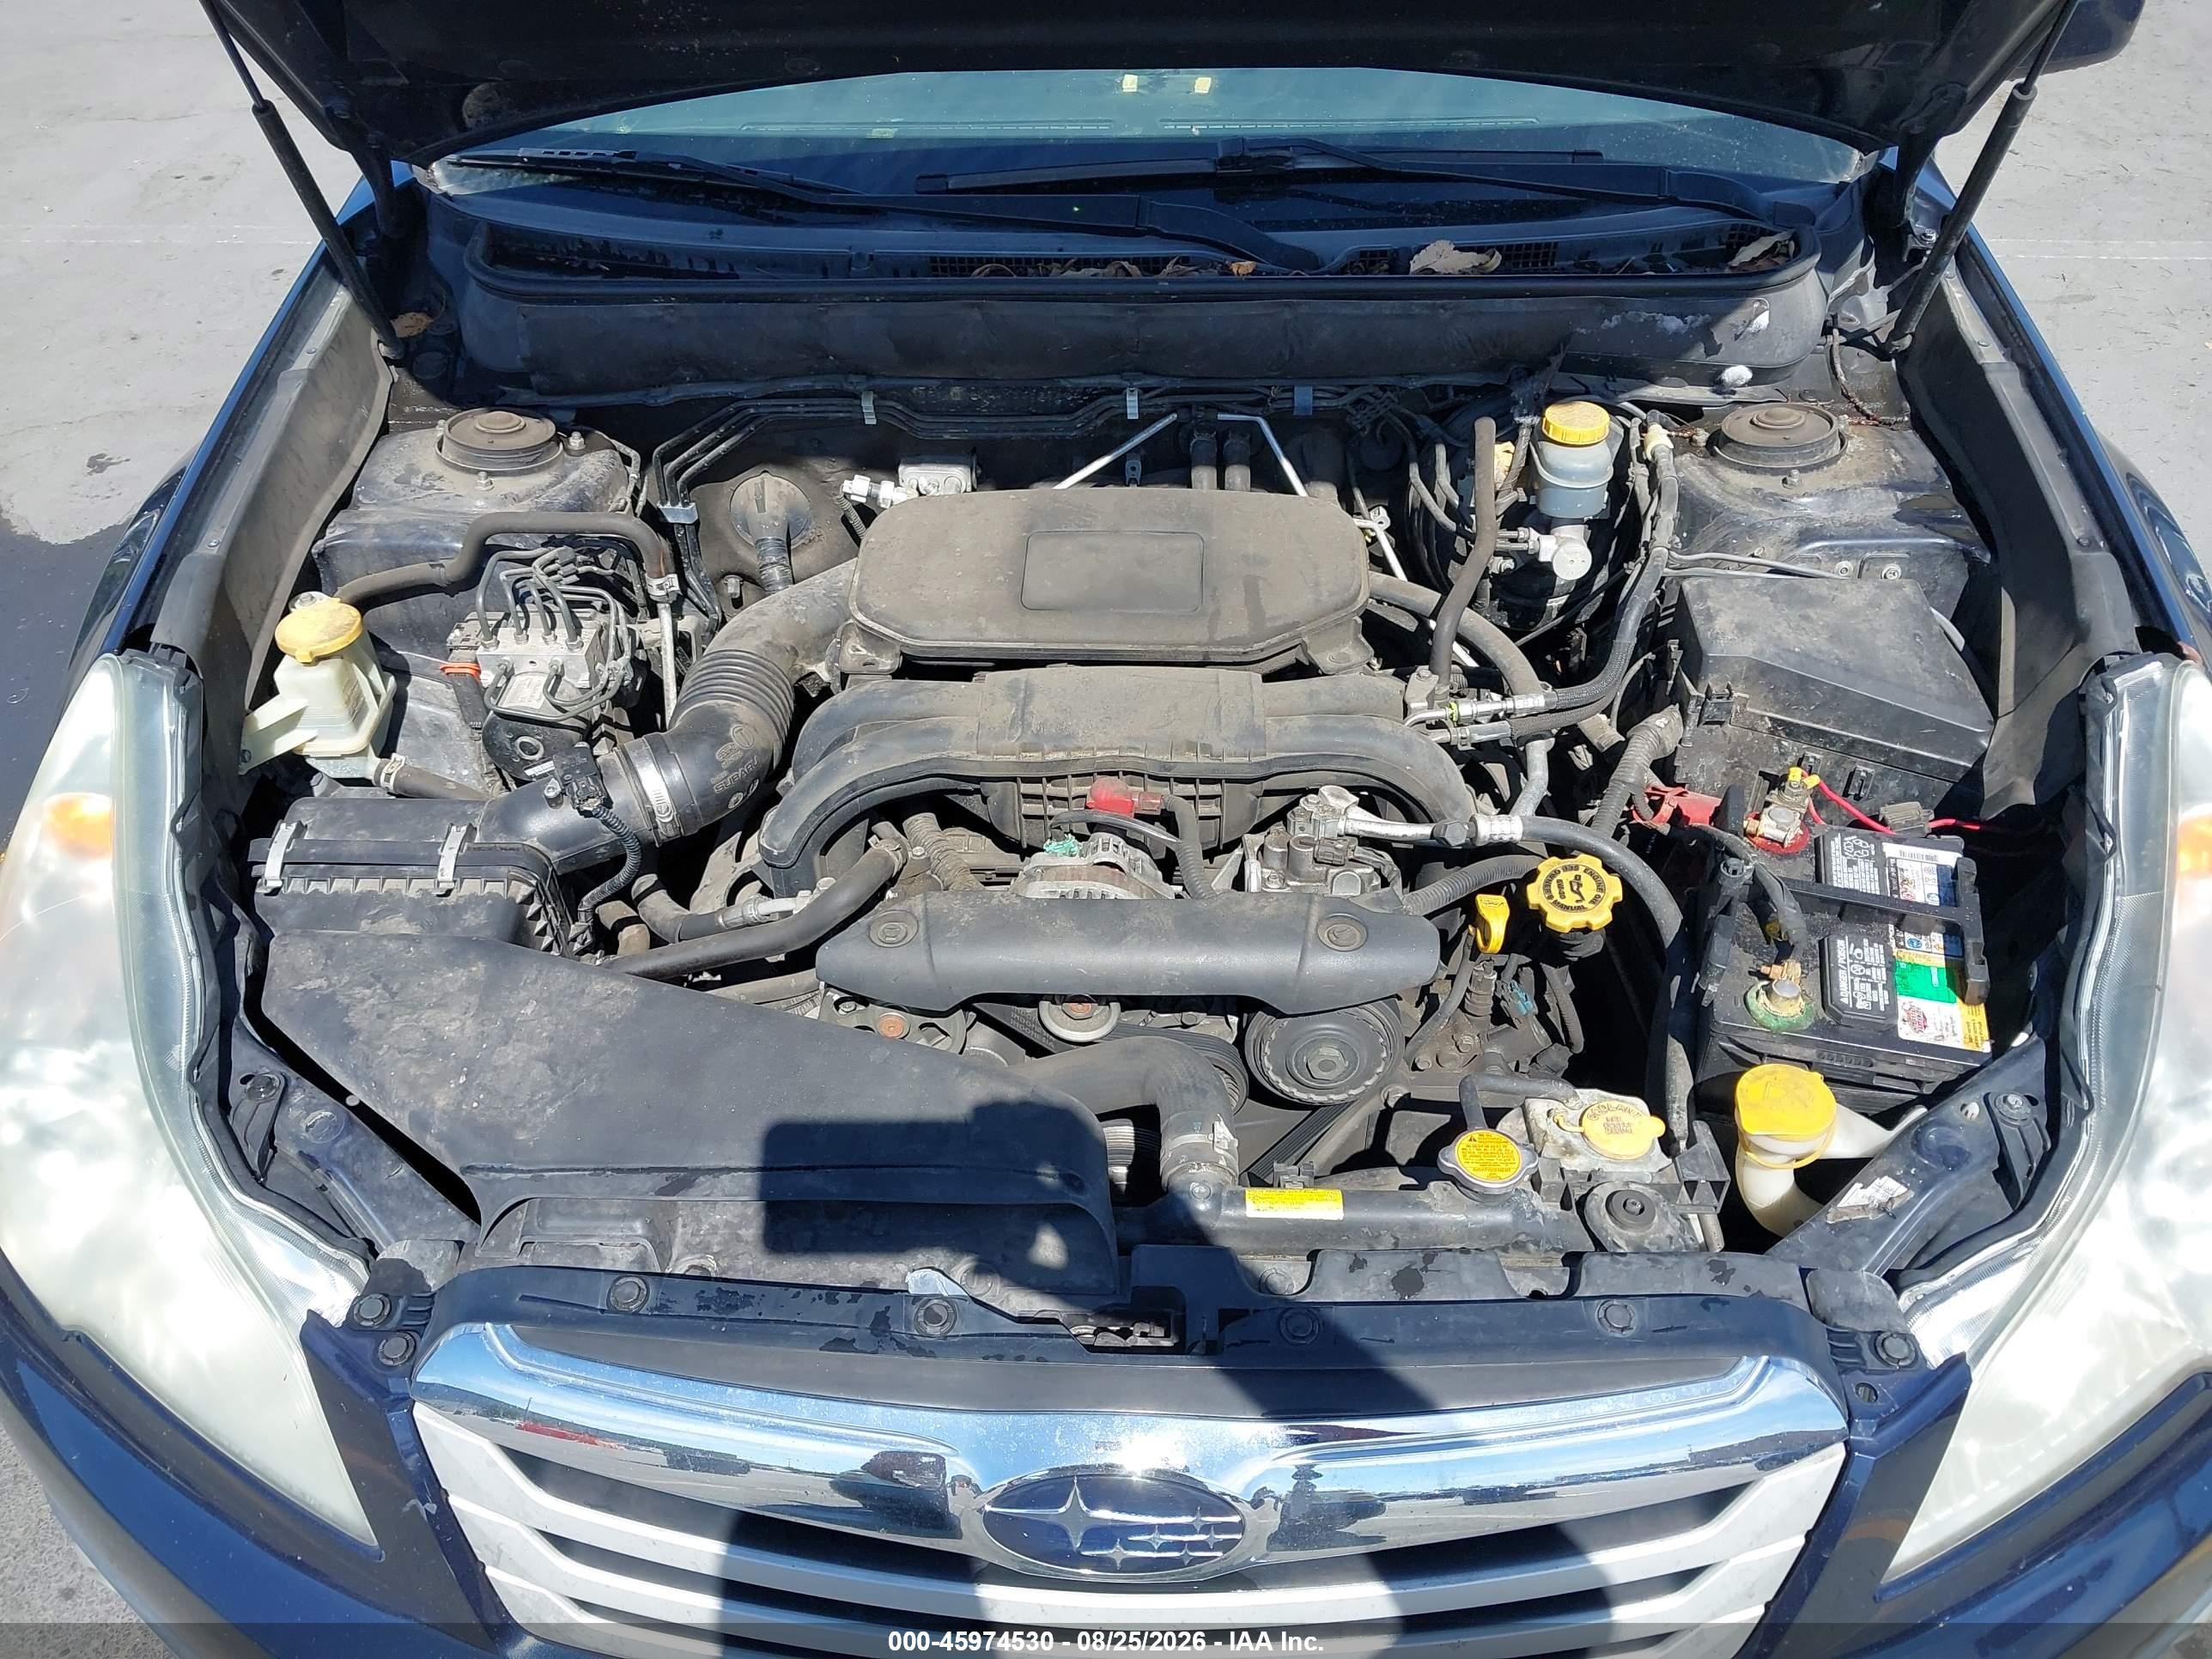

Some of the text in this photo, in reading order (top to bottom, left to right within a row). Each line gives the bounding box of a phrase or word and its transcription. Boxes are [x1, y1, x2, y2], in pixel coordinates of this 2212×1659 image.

[714, 756, 758, 793] SUBARU
[1583, 868, 1604, 905] ENGINE OIL
[1552, 899, 1588, 911] MANUAL
[1587, 1102, 1643, 1121] COOLANT
